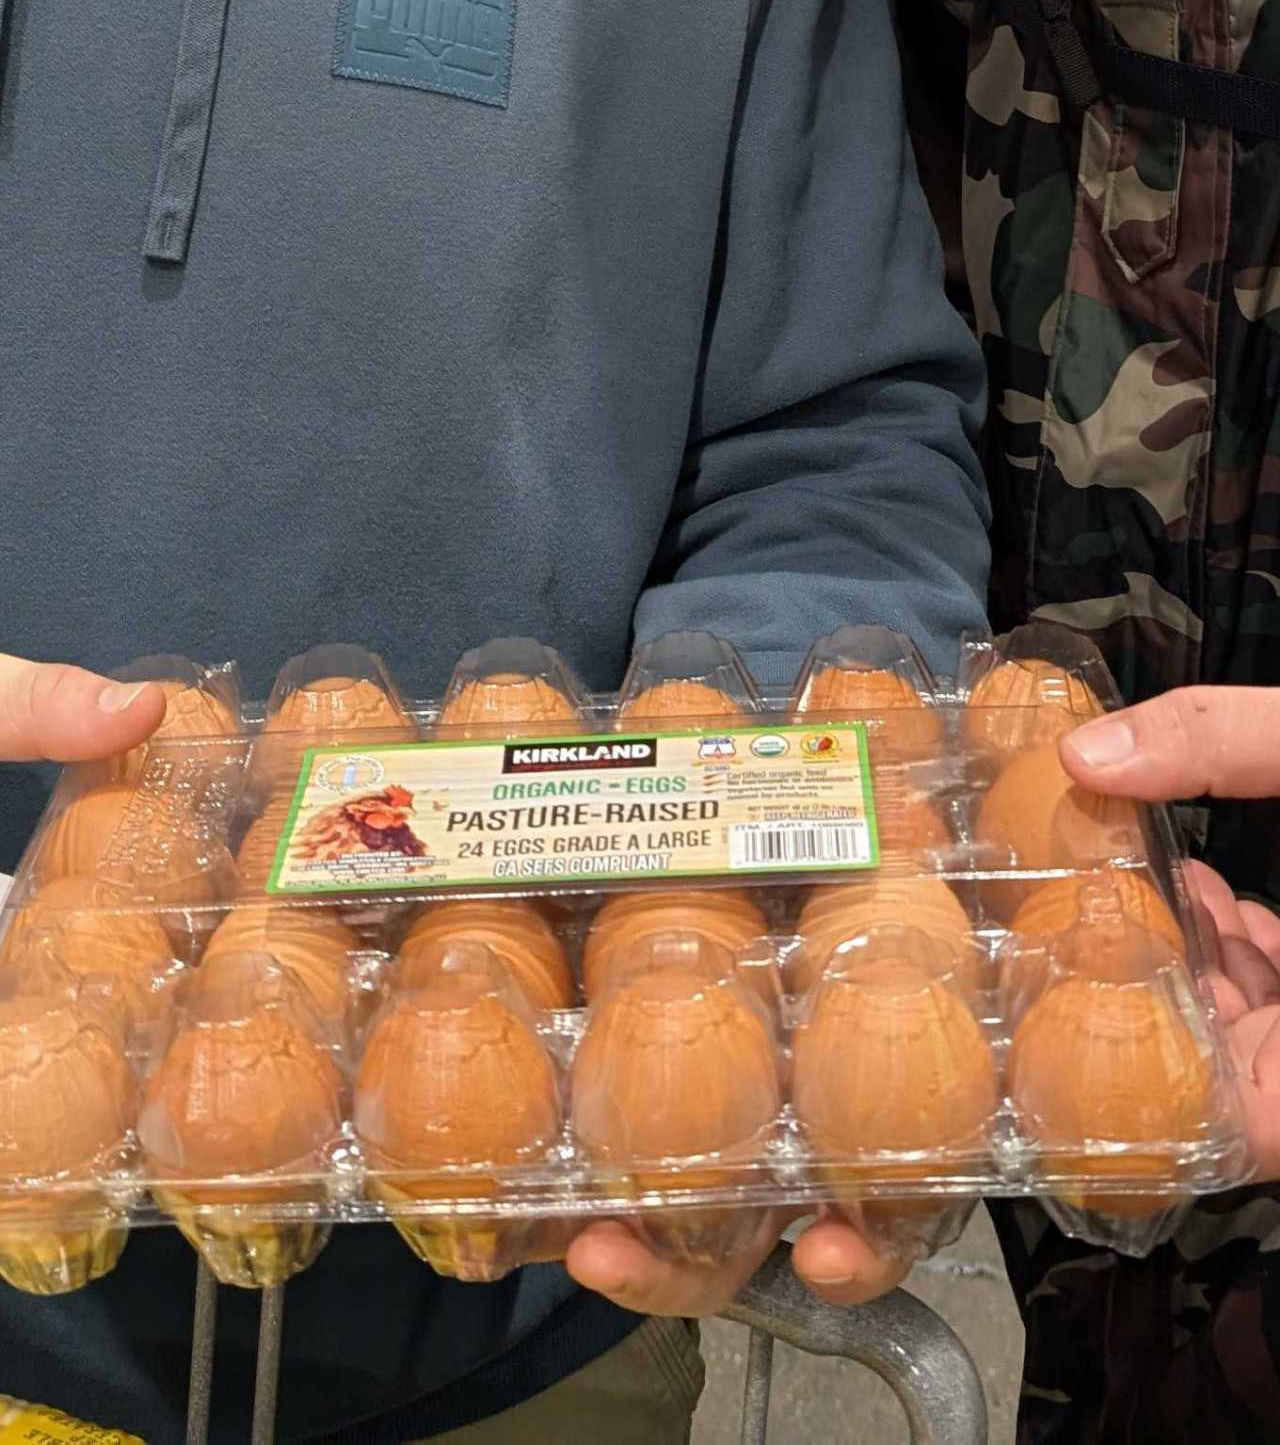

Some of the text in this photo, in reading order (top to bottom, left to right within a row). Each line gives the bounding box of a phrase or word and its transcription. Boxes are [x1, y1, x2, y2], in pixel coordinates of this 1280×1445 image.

[512, 744, 652, 765] KIRKLAND
[493, 779, 601, 800] ORGANIC
[626, 776, 687, 795] EGGS
[446, 800, 720, 833] PASTURE-RAISED
[457, 829, 712, 859] 24 EGGS GRADE A LARGE
[522, 857, 563, 875] SEFS
[570, 853, 670, 874] COMPLIANT
